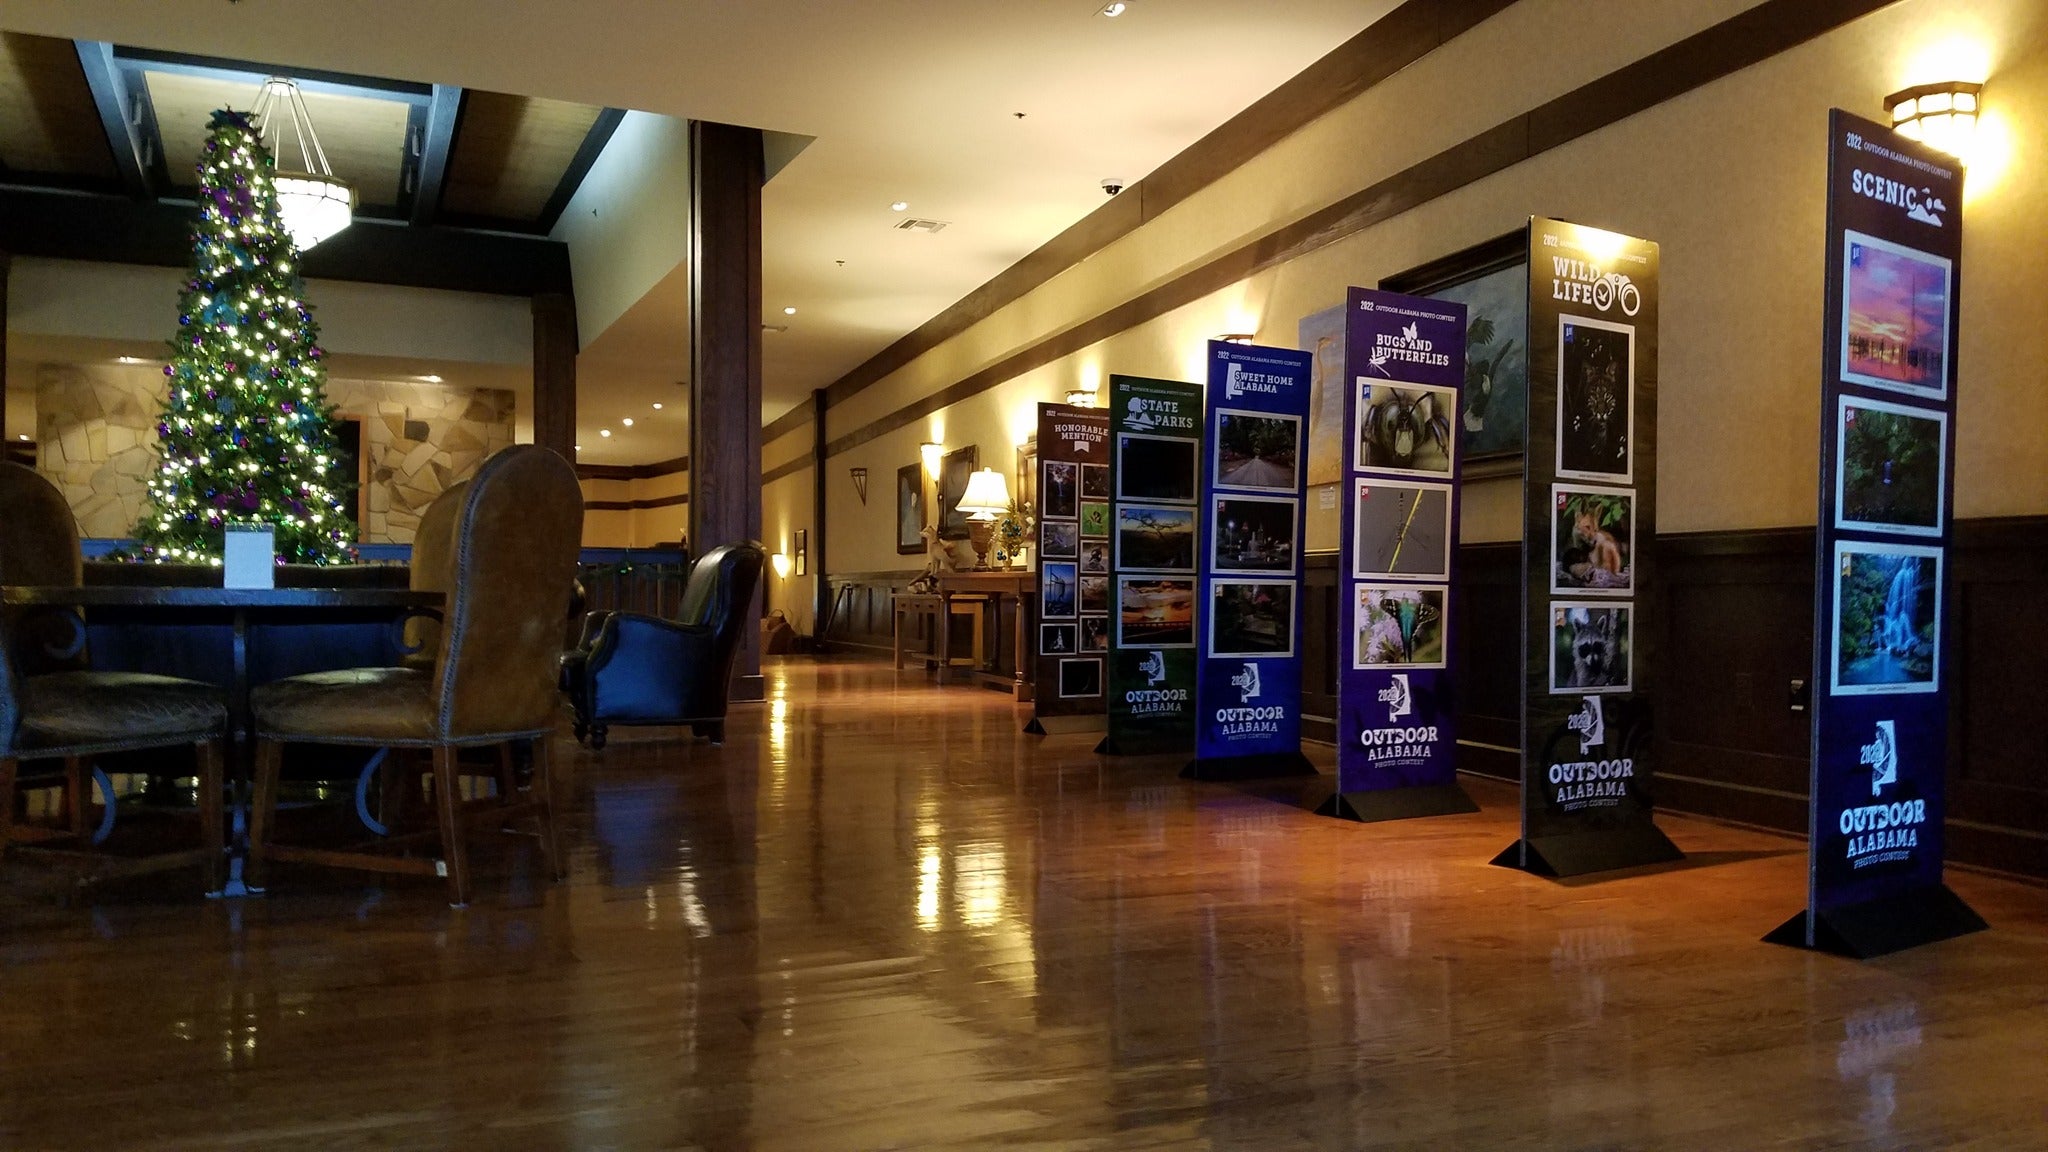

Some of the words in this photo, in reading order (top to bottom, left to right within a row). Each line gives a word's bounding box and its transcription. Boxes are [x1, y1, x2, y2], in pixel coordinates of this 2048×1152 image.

[1846, 131, 1862, 151] 2022
[1863, 141, 1889, 157] OUTDOOR
[1889, 151, 1913, 167] ALABAMA
[1913, 158, 1931, 173] PHOTO
[1930, 165, 1952, 180] CONTEST
[1852, 168, 1917, 211] SCENIC
[1543, 234, 1558, 248] 2022
[1553, 255, 1600, 282] WILD
[1553, 279, 1592, 305] LIFE
[1360, 300, 1374, 311] 2022
[1376, 304, 1398, 314] OUTDOOR
[1399, 308, 1420, 317] ALABAMA
[1420, 311, 1435, 319] PHOTO
[1436, 314, 1456, 322] CONTEST
[1376, 334, 1406, 348] BUGS
[1408, 339, 1432, 352] AND
[1217, 350, 1229, 360] 2022
[1376, 346, 1449, 366] BUTTERFLIES
[1235, 371, 1265, 383] SWEET
[1267, 375, 1294, 386] HOME
[1234, 381, 1277, 393] ALABAMA
[1141, 398, 1179, 413] STATE
[1154, 414, 1193, 429] PARKS
[1054, 424, 1108, 437] HONORABLE
[1061, 432, 1102, 443] MENTION
[1126, 689, 1188, 703] OUTDOOR
[1131, 702, 1182, 714] ALABAMA
[1216, 706, 1284, 722] OUTDOOR
[1222, 721, 1278, 735] ALABAMA
[1361, 726, 1438, 746] OUTDOOR
[1367, 745, 1432, 761] ALABAMA
[1548, 758, 1634, 784] OUTDOOR
[1556, 781, 1627, 803] ALABAMA
[1839, 799, 1926, 835] OUTDOOR
[1846, 828, 1918, 858] ALABAMA
